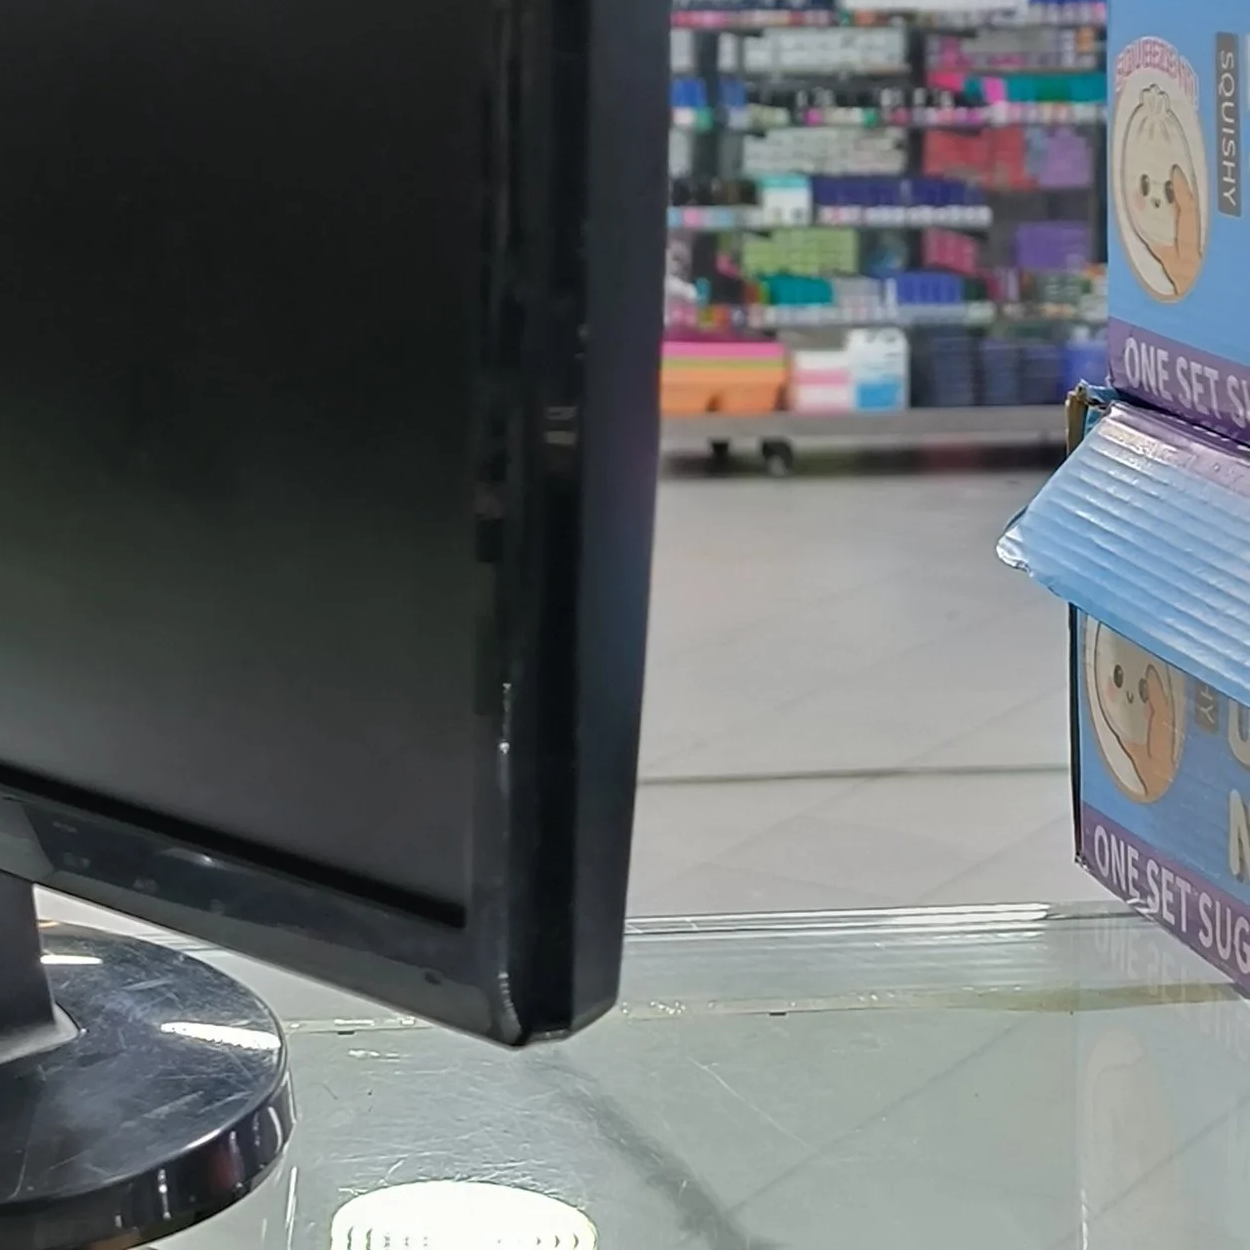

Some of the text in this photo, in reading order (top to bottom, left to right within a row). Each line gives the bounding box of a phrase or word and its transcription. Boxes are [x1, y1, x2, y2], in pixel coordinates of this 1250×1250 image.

[1218, 50, 1236, 207] SQUISHY
[1124, 337, 1174, 402] ONE
[1176, 356, 1222, 420] SET
[1094, 825, 1140, 900] ONE
[1146, 859, 1191, 933] SET
